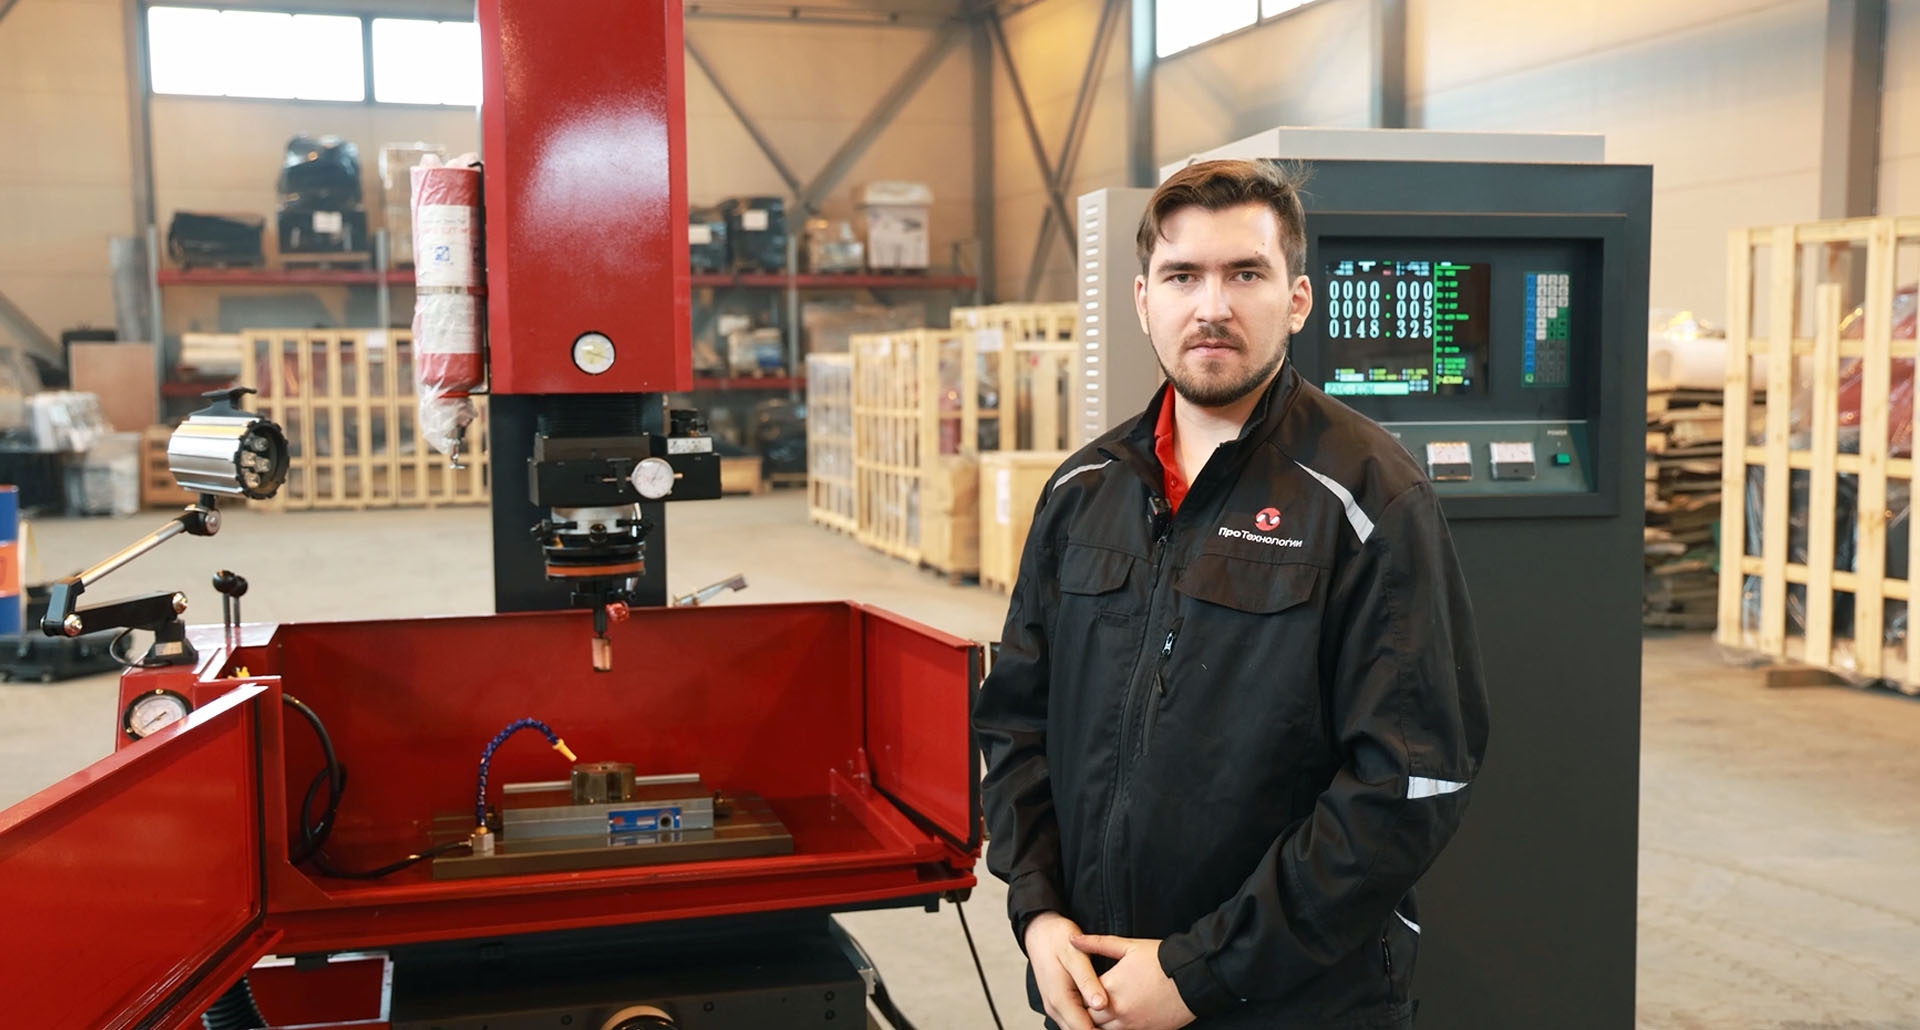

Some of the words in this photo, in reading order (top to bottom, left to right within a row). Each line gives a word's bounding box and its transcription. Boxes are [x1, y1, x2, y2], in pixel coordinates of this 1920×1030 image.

[1329, 300, 1433, 319] 0000.005
[1329, 319, 1433, 338] 0148.325
[1218, 526, 1303, 548] ПроТехнологии
